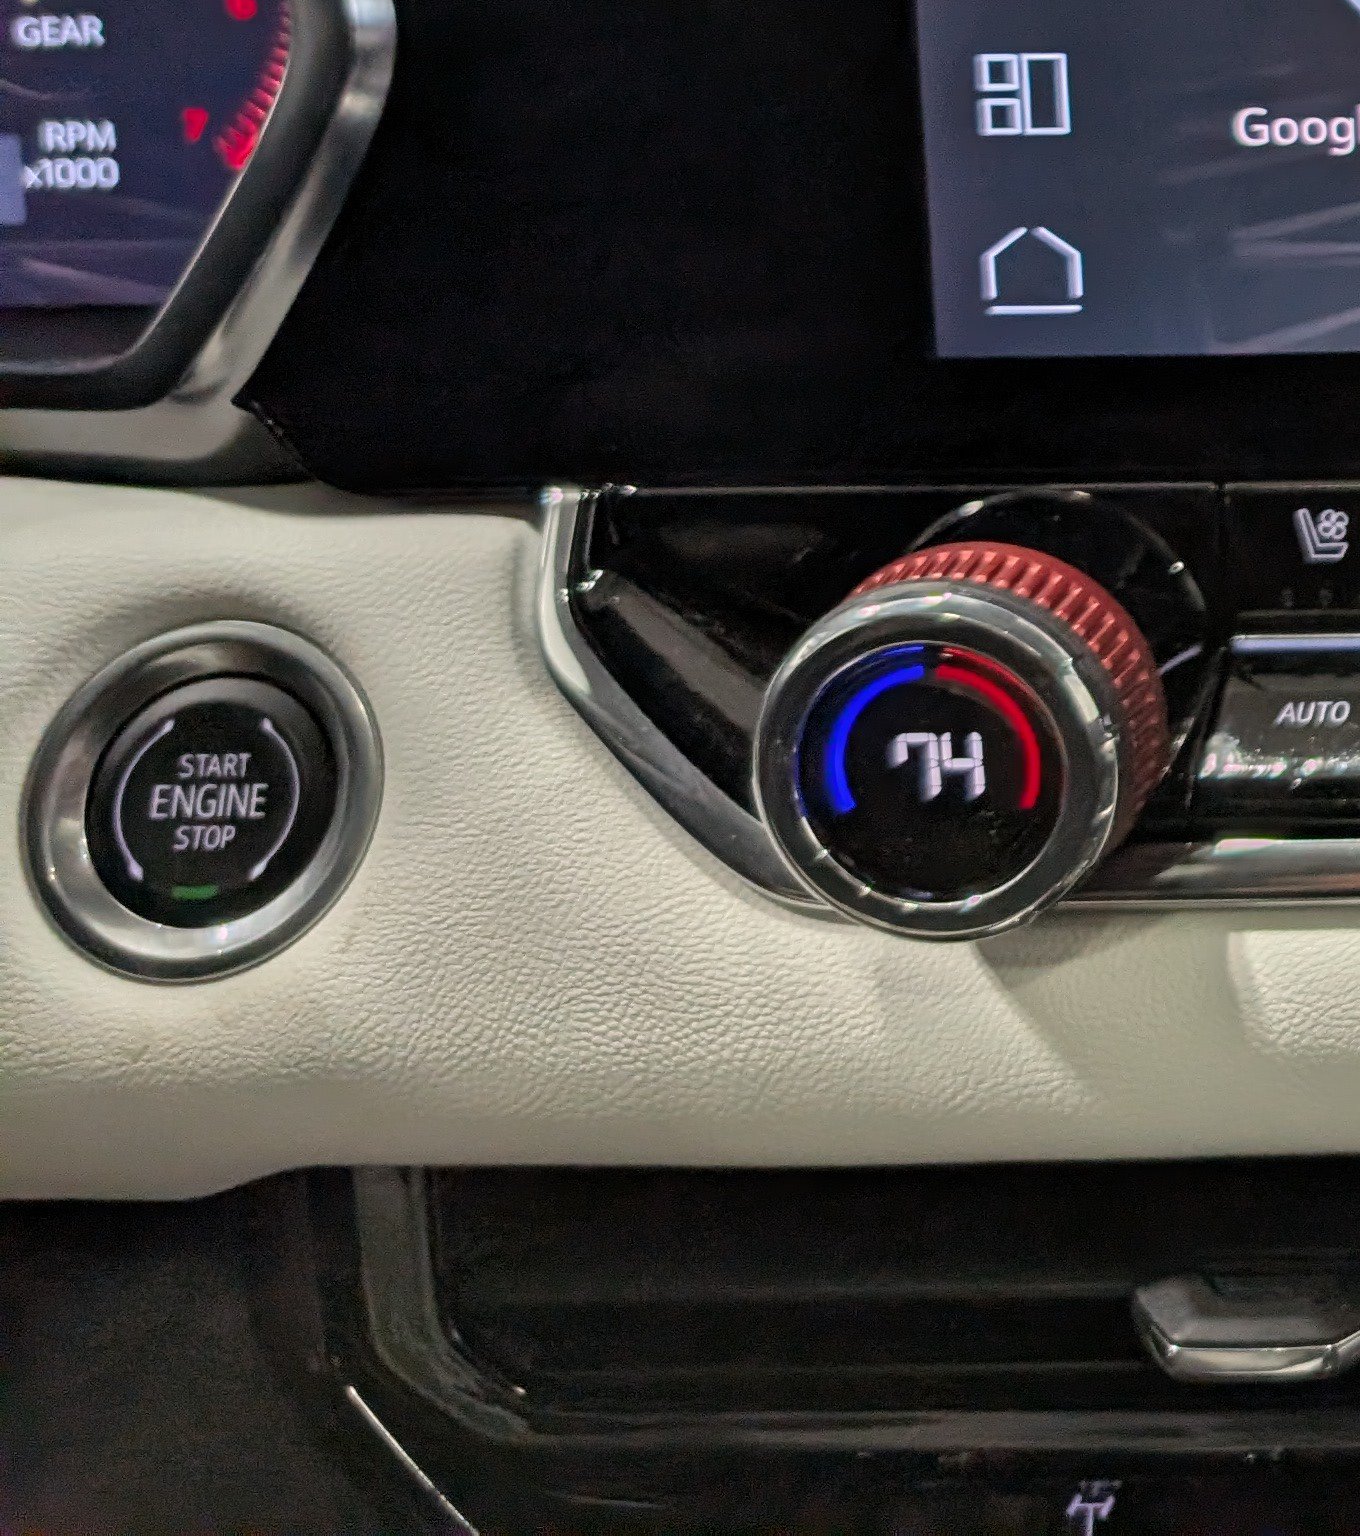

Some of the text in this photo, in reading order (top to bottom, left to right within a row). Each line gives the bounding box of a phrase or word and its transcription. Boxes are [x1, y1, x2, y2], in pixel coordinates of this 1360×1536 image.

[13, 15, 104, 47] GEAR
[41, 121, 116, 151] RPM
[184, 108, 209, 142] 7
[1276, 701, 1350, 724] AUTO
[179, 753, 250, 778] START
[892, 732, 985, 798] 74
[149, 783, 267, 819] ENGINE
[173, 825, 235, 850] STOP
